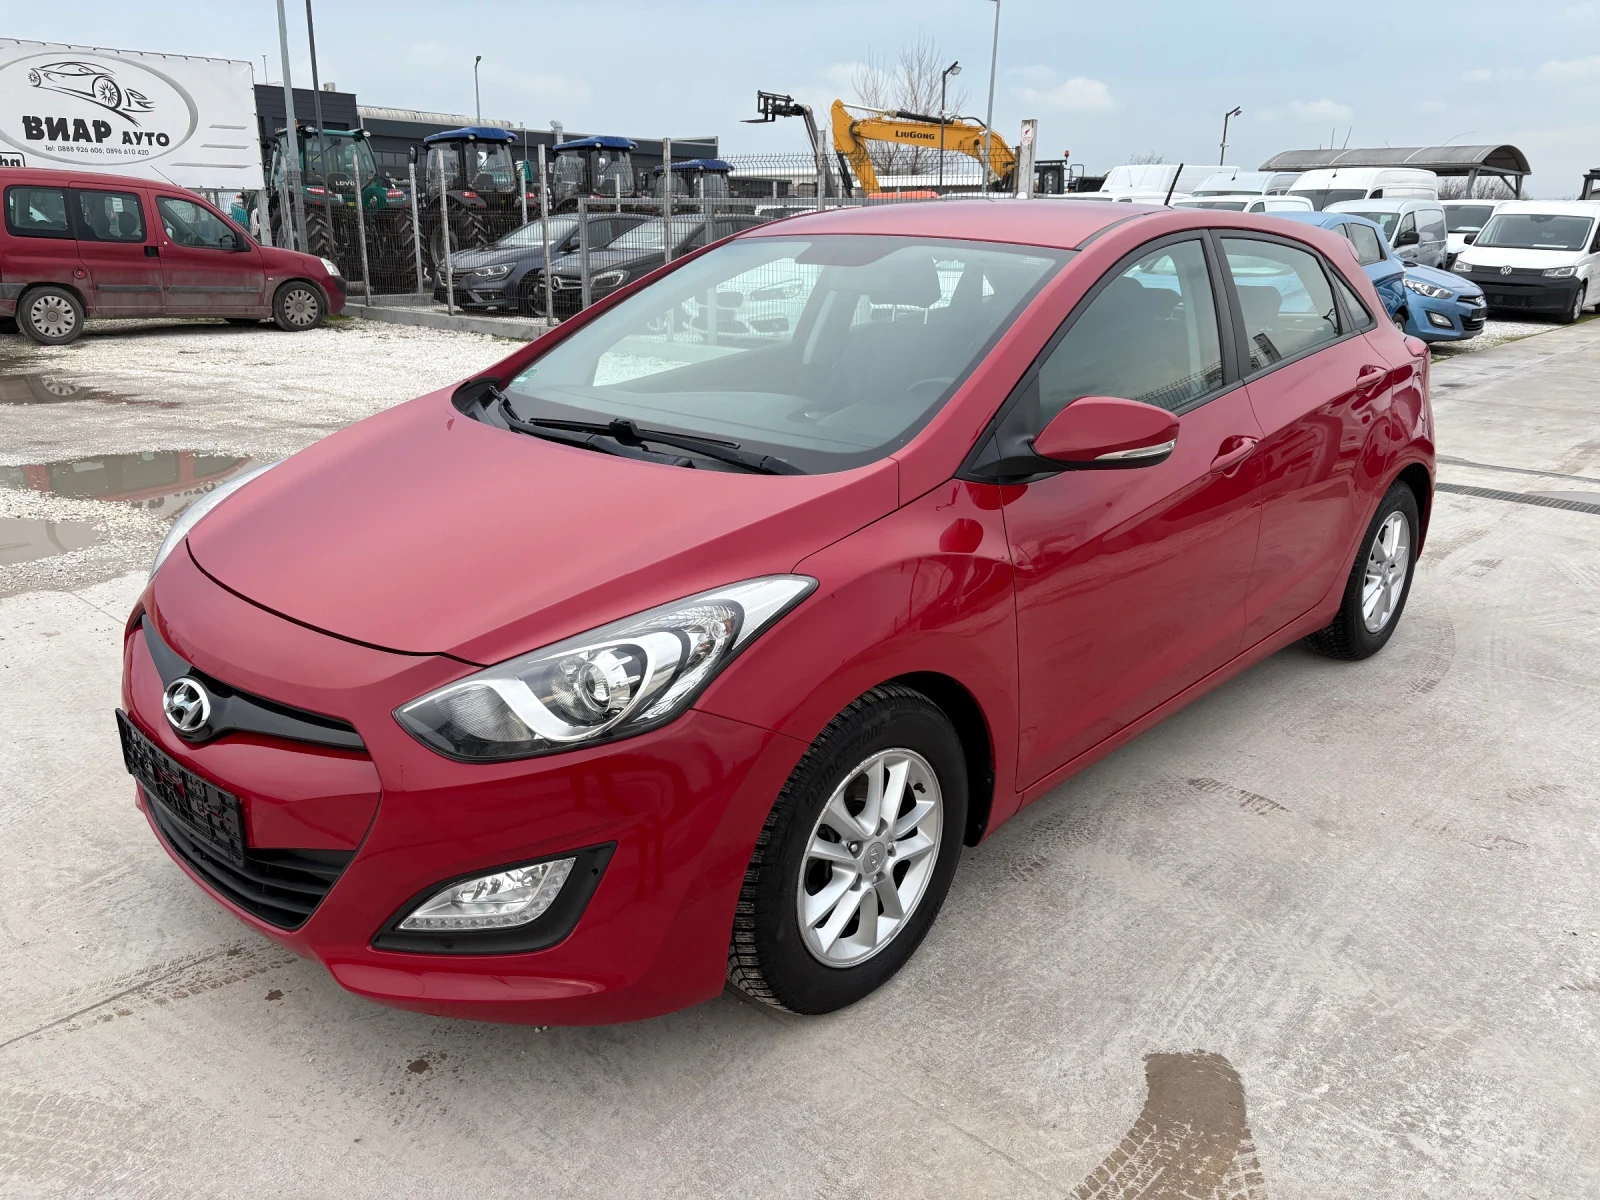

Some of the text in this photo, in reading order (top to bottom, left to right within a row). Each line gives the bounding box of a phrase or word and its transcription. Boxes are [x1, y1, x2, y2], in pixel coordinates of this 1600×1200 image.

[22, 115, 170, 147] ВИАР АУТО
[45, 144, 56, 152] Tel:
[57, 145, 75, 153] 0888
[90, 146, 105, 155] 606;
[105, 147, 122, 155] 0896
